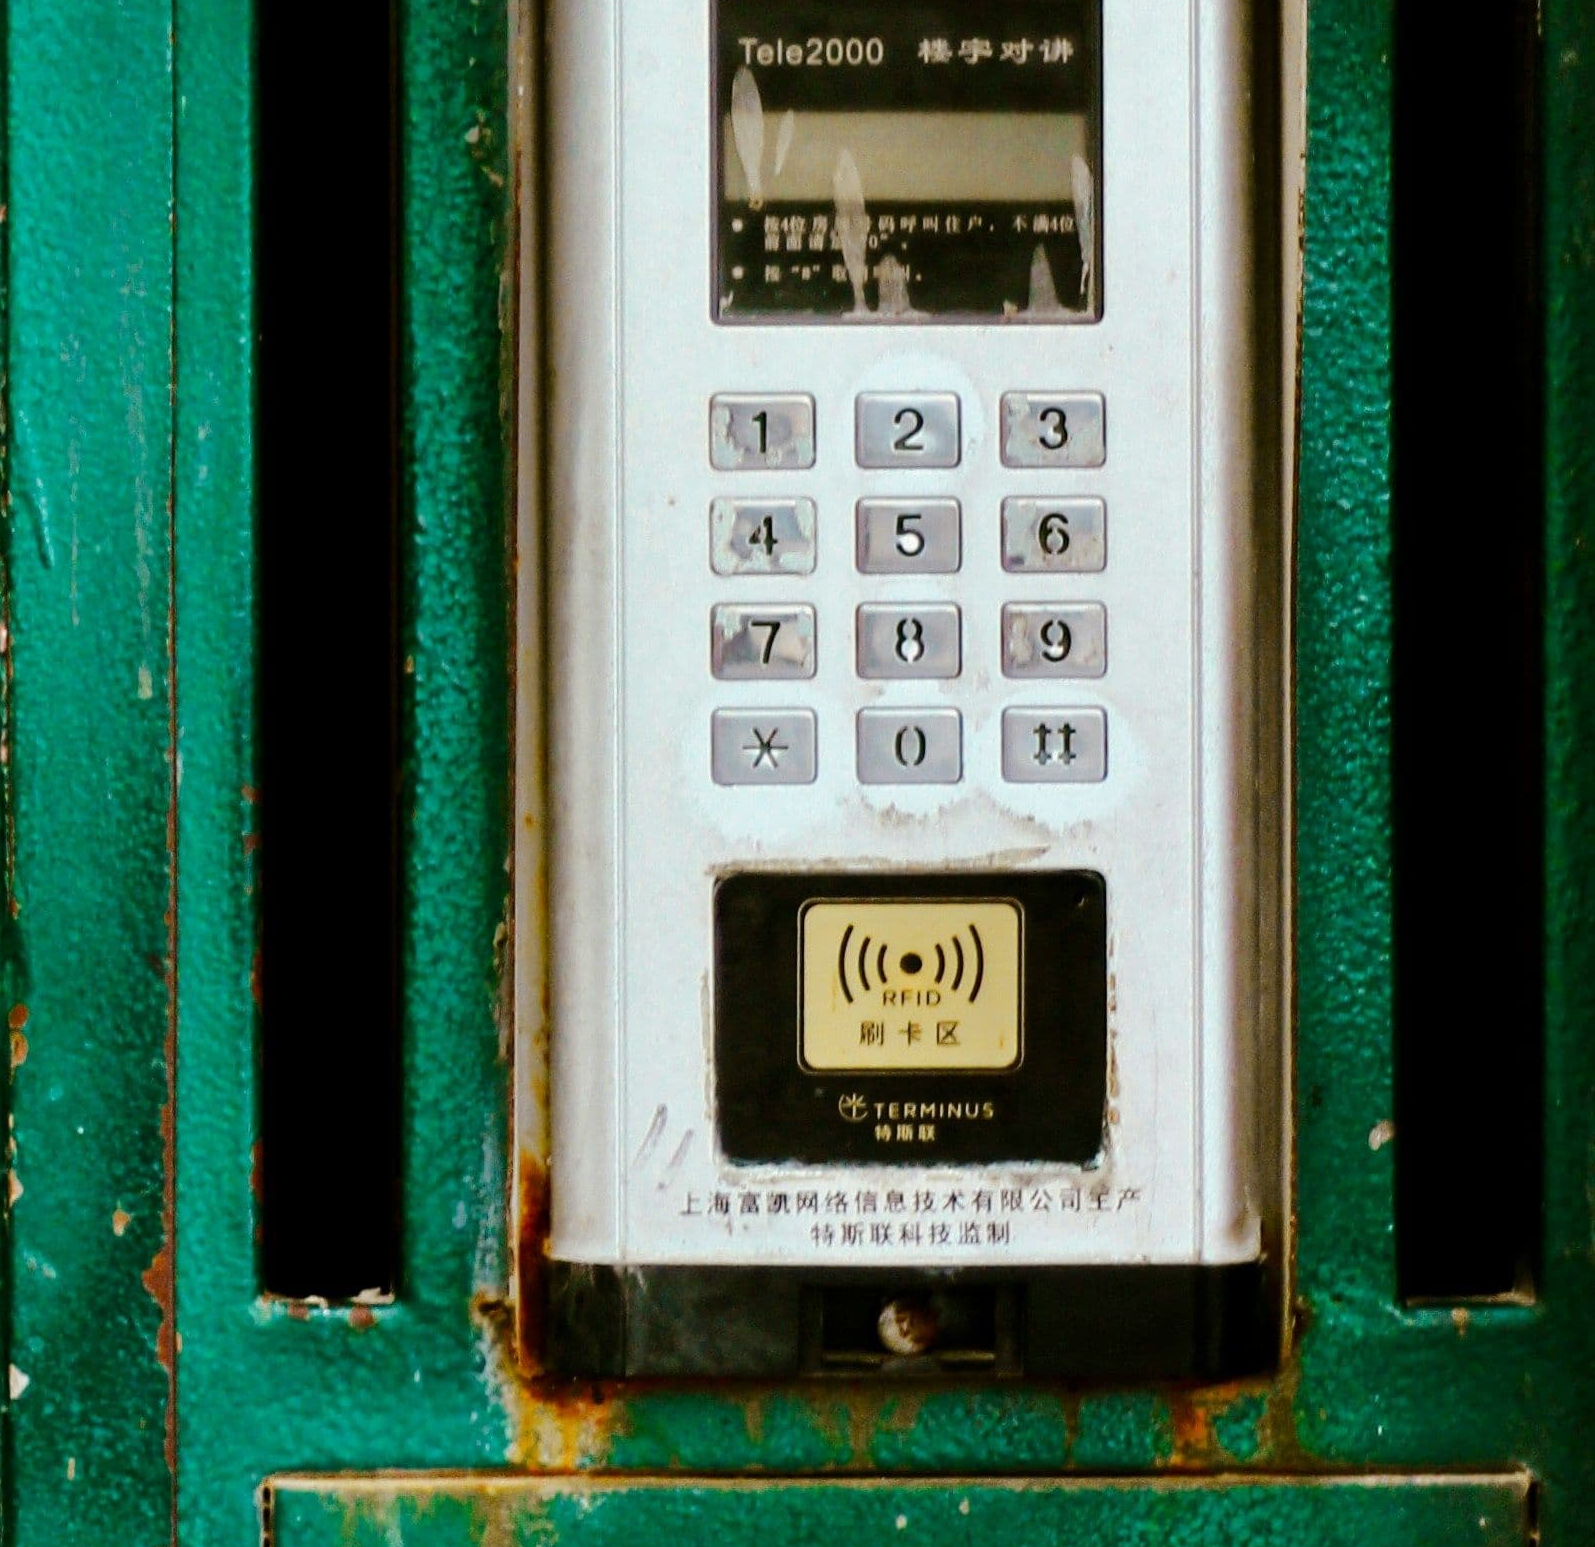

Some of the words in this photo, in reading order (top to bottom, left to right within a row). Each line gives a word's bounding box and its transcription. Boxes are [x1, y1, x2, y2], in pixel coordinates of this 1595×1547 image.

[739, 38, 885, 66] Tele2000
[918, 37, 1075, 66] 楼宇对讲
[751, 410, 769, 453] 1
[893, 409, 925, 451] 2
[1039, 408, 1069, 450] 3
[748, 516, 778, 556] 4
[895, 514, 925, 556] 5
[1038, 513, 1070, 555] 6
[751, 621, 782, 664] 7
[895, 618, 924, 663] 8
[1041, 619, 1071, 663] 9
[894, 725, 926, 766] 0
[882, 990, 942, 1007] RFID
[859, 1020, 961, 1047] 刷卡区
[873, 1100, 995, 1120] TERMINUS
[874, 1123, 936, 1143] 特斯联
[810, 1221, 1012, 1247] 特斯联科技监制
